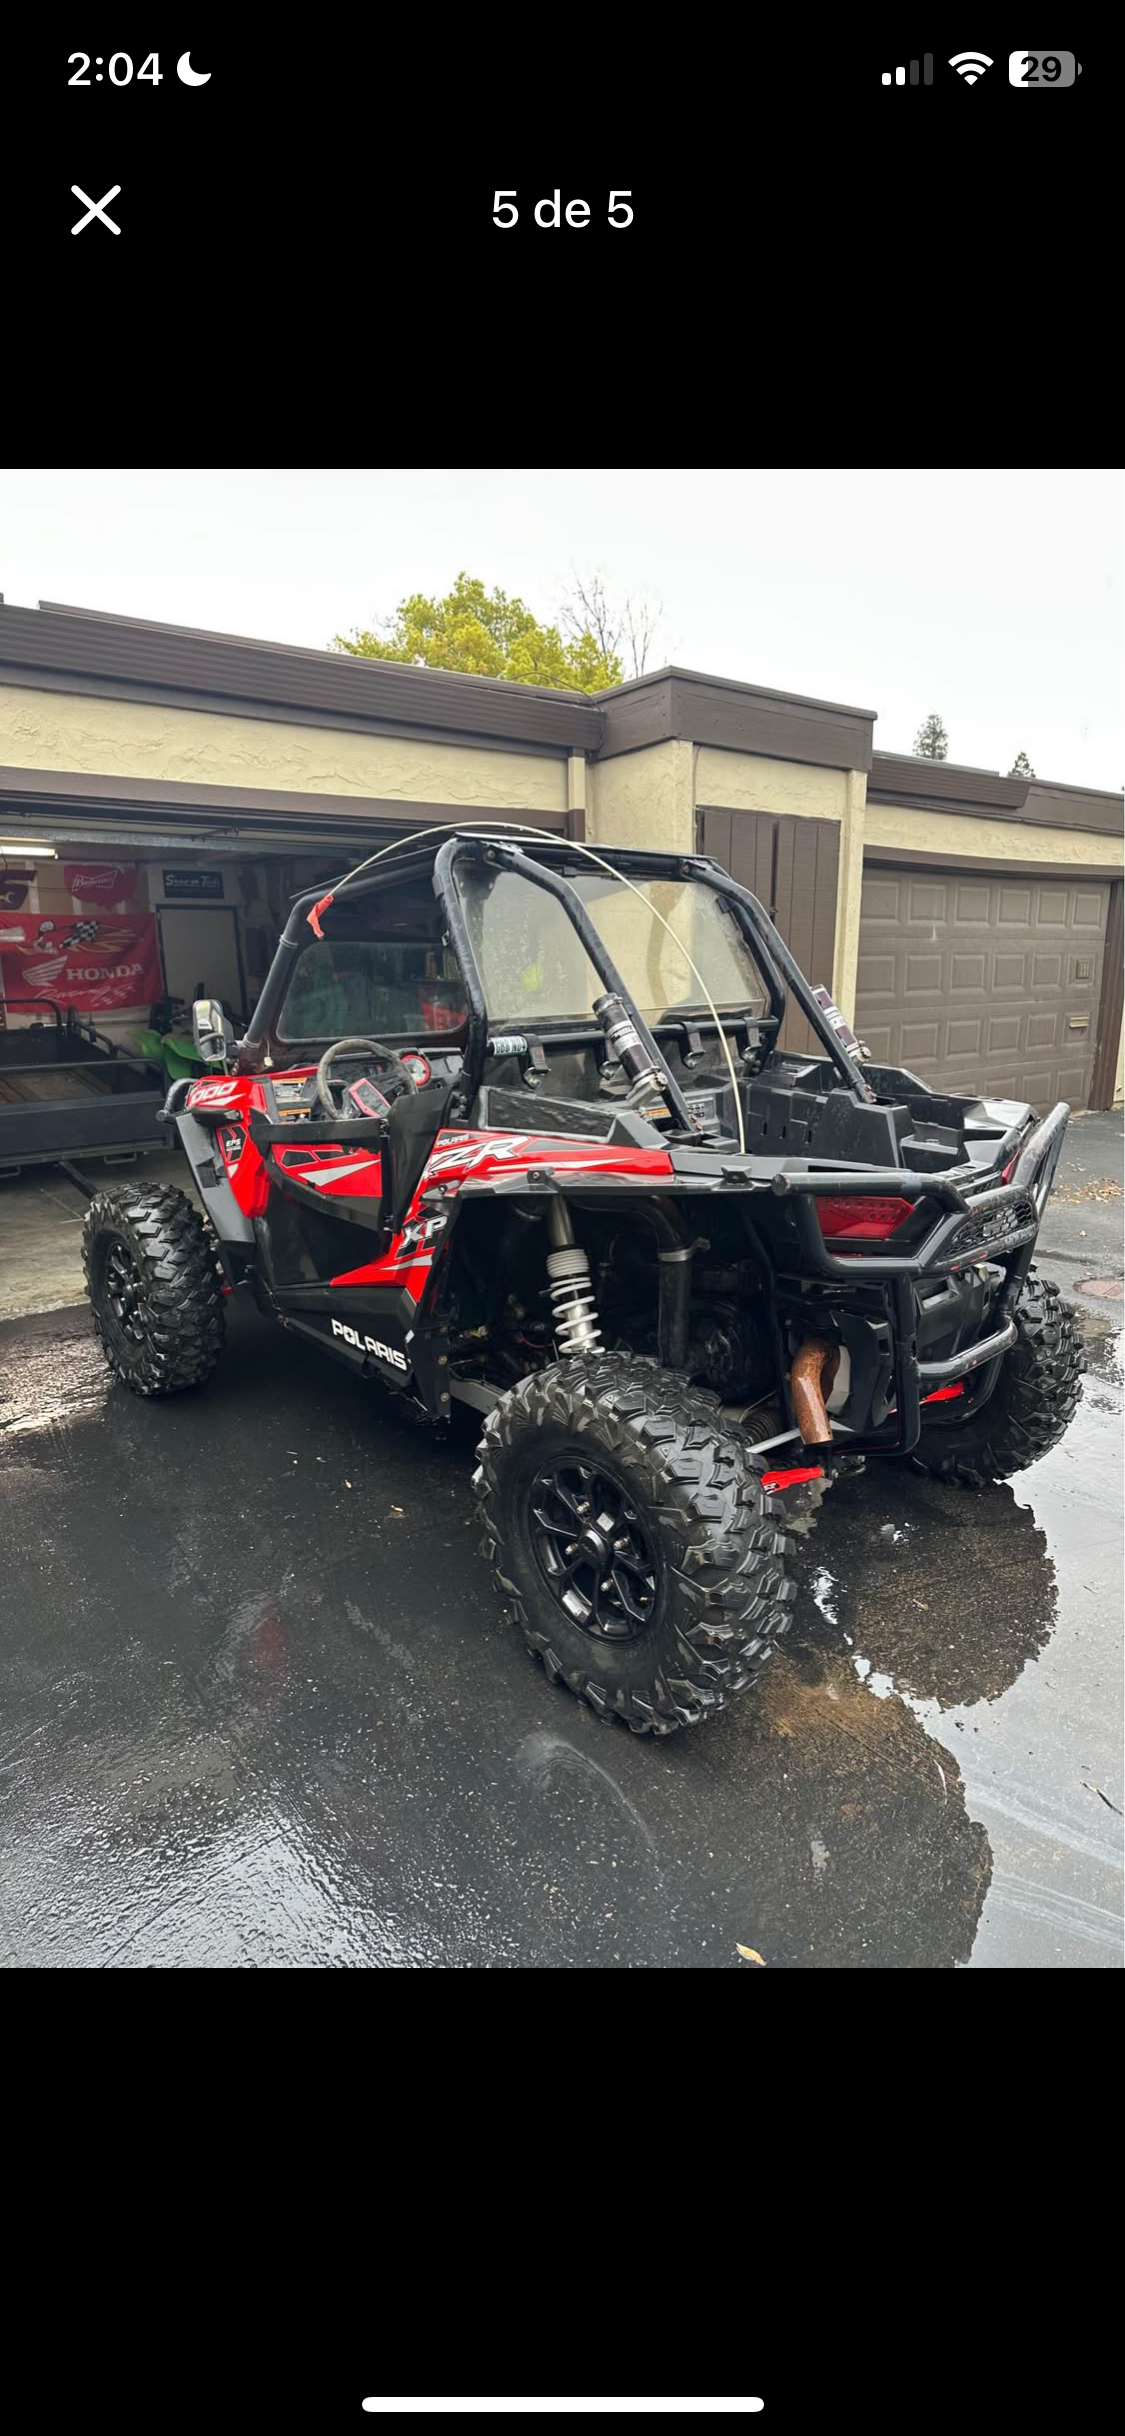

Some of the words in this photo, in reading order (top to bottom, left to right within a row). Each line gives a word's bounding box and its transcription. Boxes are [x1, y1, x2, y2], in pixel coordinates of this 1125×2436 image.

[66, 963, 145, 981] HONDA
[225, 1138, 242, 1148] EPS
[423, 1135, 529, 1179] ZR
[400, 1215, 448, 1248] XP
[331, 1318, 408, 1371] POLARIS
